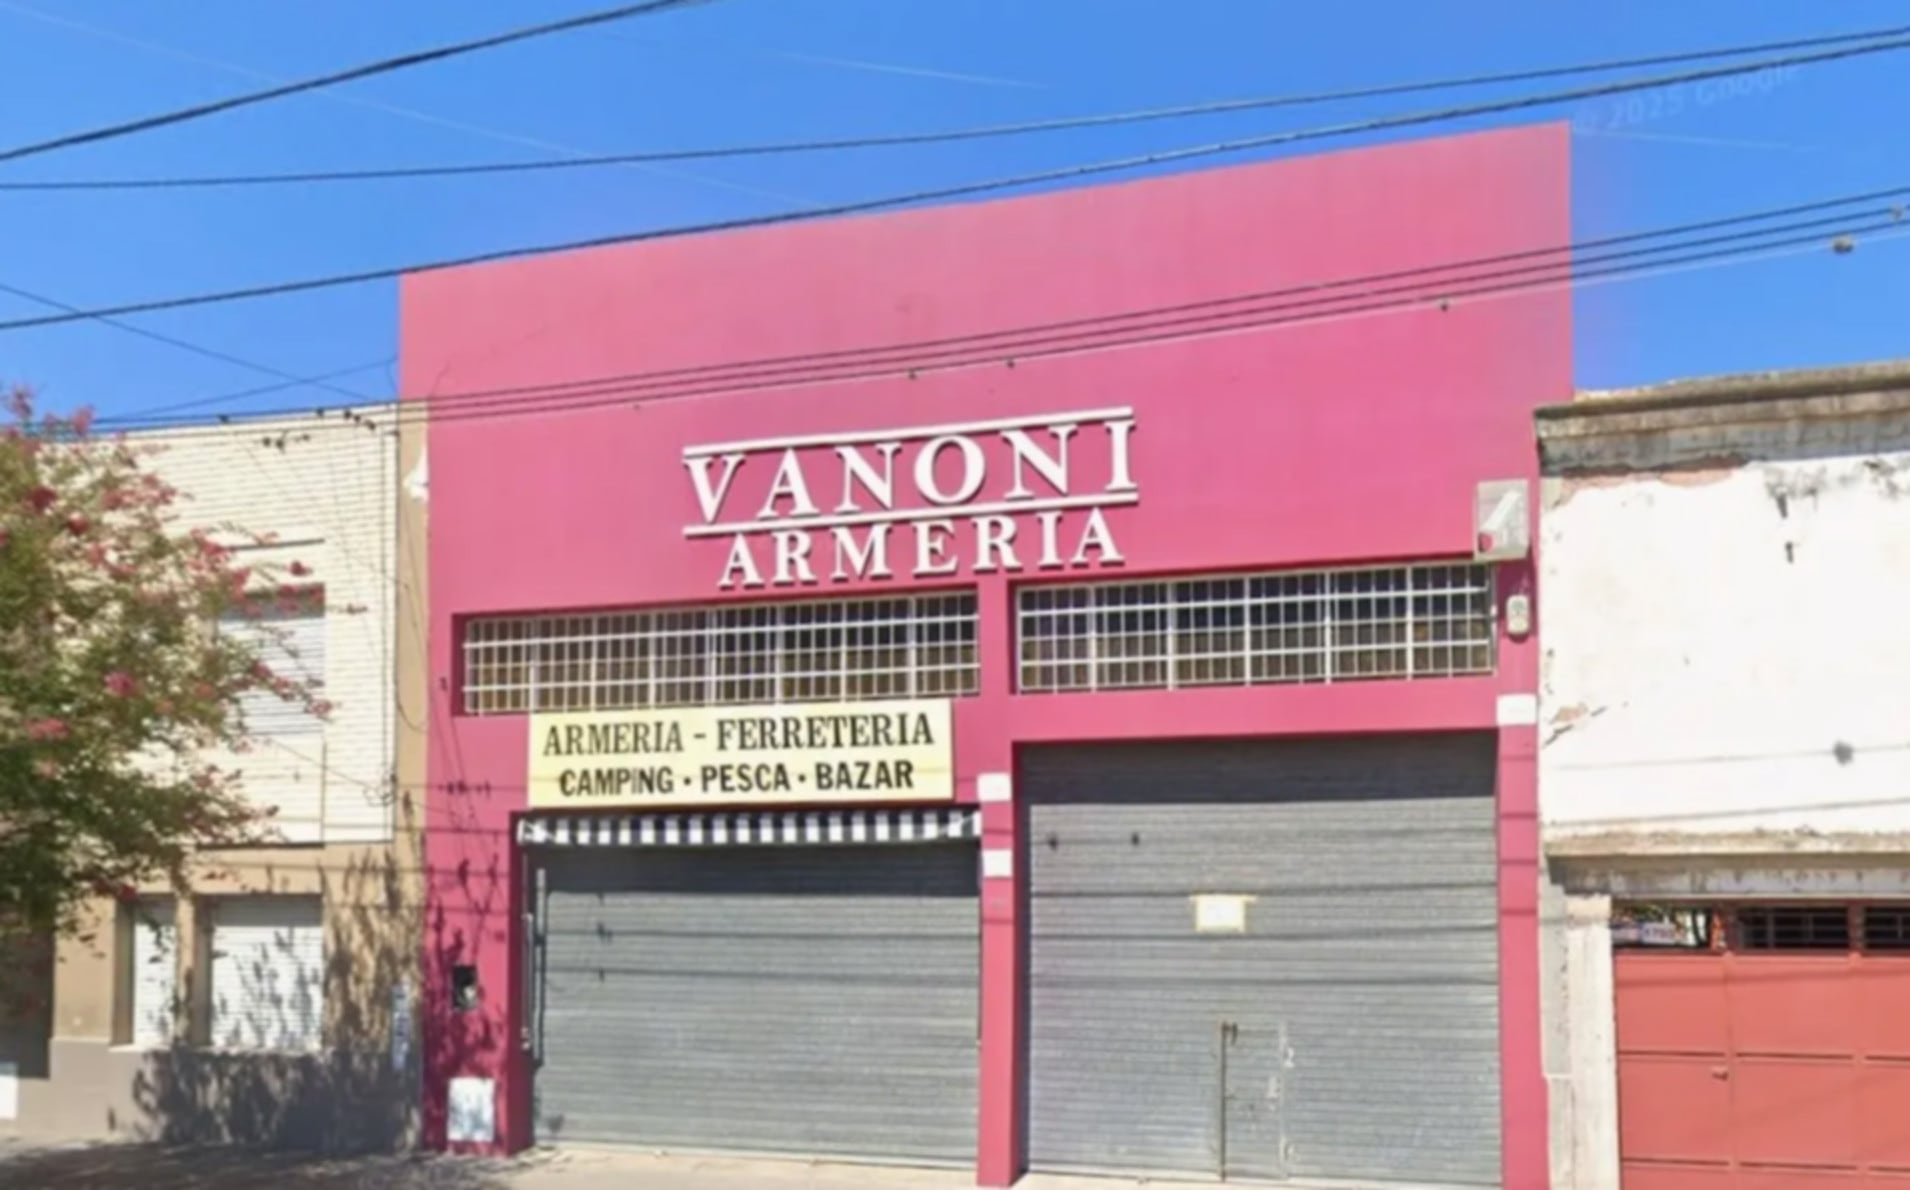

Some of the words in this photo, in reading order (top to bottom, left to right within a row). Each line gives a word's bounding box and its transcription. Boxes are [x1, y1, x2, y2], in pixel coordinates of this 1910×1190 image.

[682, 418, 1139, 525] VANONI
[717, 506, 1126, 590] ARMERIA
[543, 720, 685, 756] ARMERIA
[716, 712, 934, 752] FERRETERIA
[559, 766, 674, 797] CAMPING
[701, 763, 792, 794] PESCA
[815, 760, 914, 792] BAZAR
